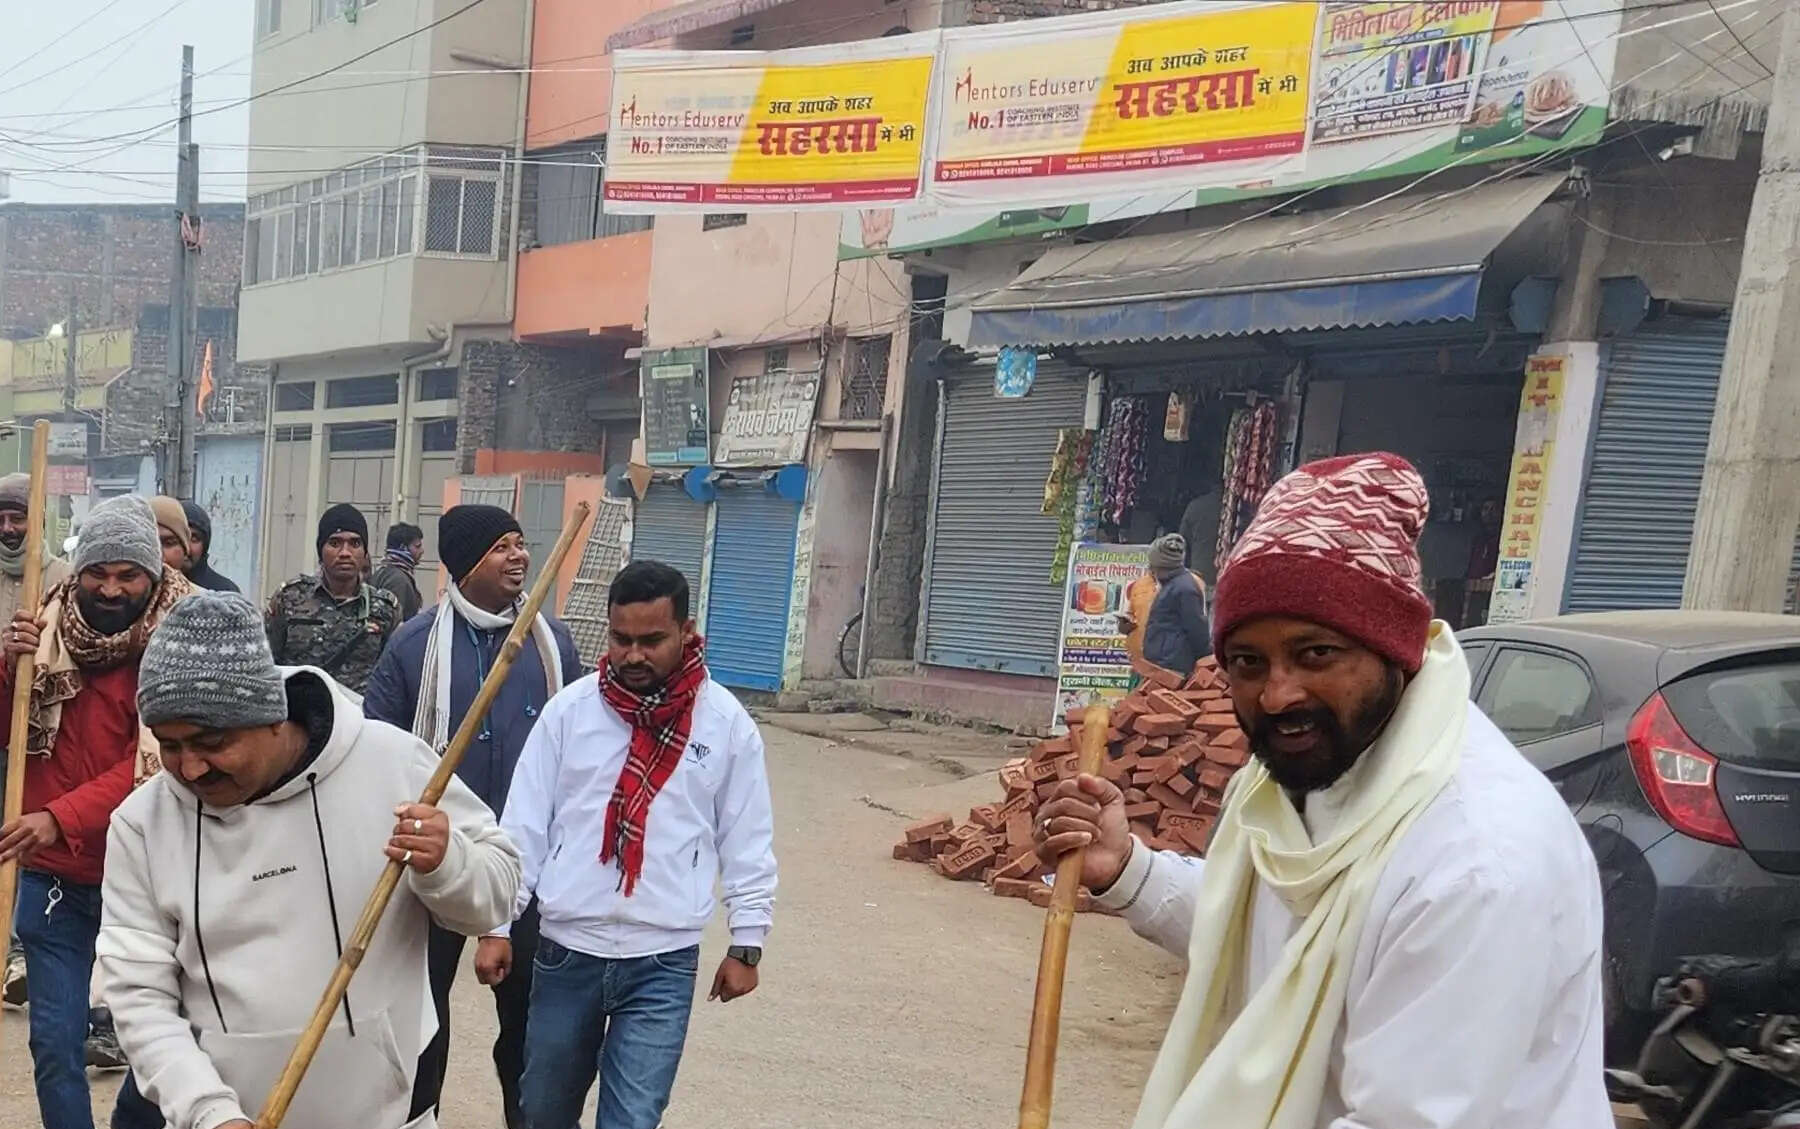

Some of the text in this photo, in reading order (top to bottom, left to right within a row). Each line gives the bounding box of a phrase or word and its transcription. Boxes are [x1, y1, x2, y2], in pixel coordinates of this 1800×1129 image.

[1161, 48, 1207, 71] आपके
[1215, 46, 1249, 63] शहर
[797, 96, 840, 113] आपके
[844, 97, 874, 111] शहर
[1113, 68, 1299, 120] सहरसा में भी
[757, 118, 916, 155] सहरसा में भी
